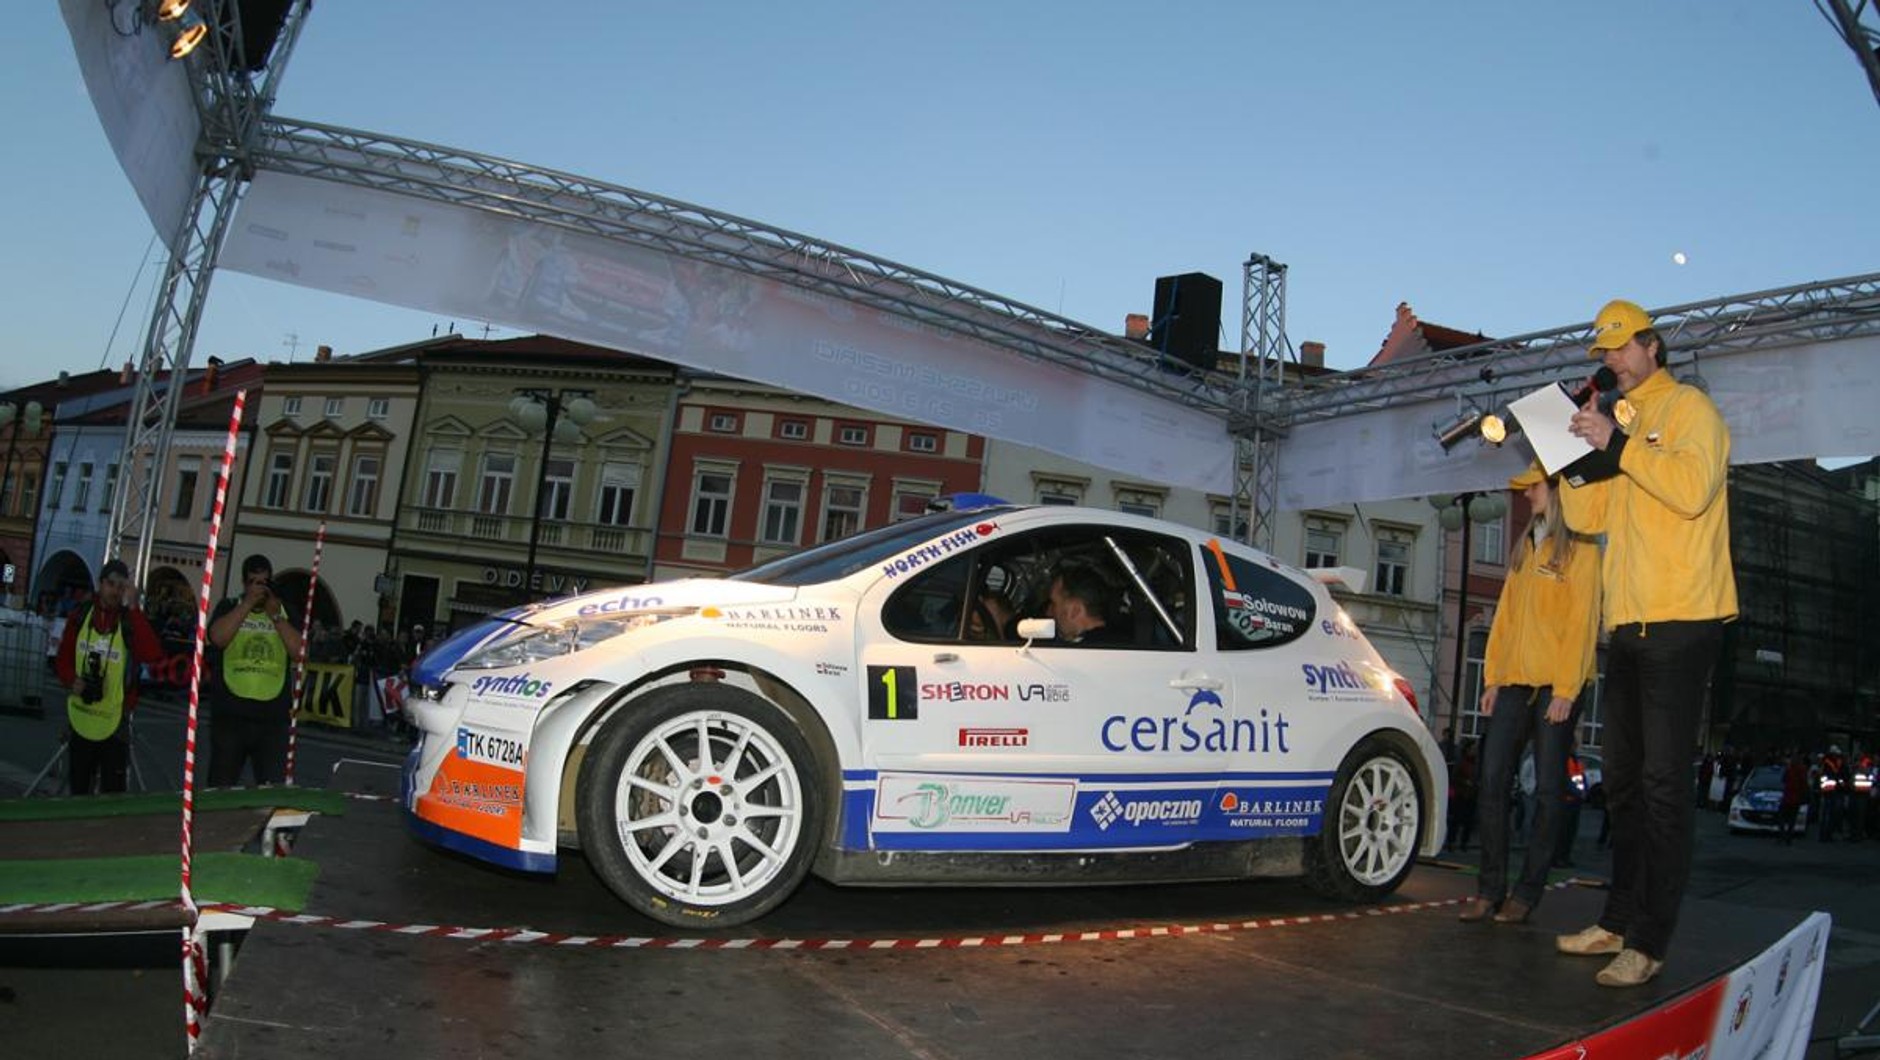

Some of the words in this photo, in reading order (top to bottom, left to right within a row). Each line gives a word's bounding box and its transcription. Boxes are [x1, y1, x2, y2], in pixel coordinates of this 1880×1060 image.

[883, 544, 942, 579] NORTH
[940, 529, 978, 553] FISH
[578, 596, 663, 616] echo
[783, 624, 829, 633] FLOORS
[1264, 617, 1294, 633] Baran
[471, 672, 553, 698] synthos
[1302, 660, 1386, 694] synth
[881, 667, 898, 719] 1
[921, 681, 1009, 703] SHERON
[959, 728, 1029, 747] PIRELLI
[1101, 708, 1290, 754] cersanit
[468, 732, 485, 758] TK
[487, 735, 524, 766] 6728A
[907, 783, 1011, 829] Bonver
[1124, 798, 1203, 827] opoczno
[1239, 800, 1323, 814] BARLINEK
[1229, 818, 1273, 828] NATURAL
[1275, 818, 1309, 828] FLOORS
